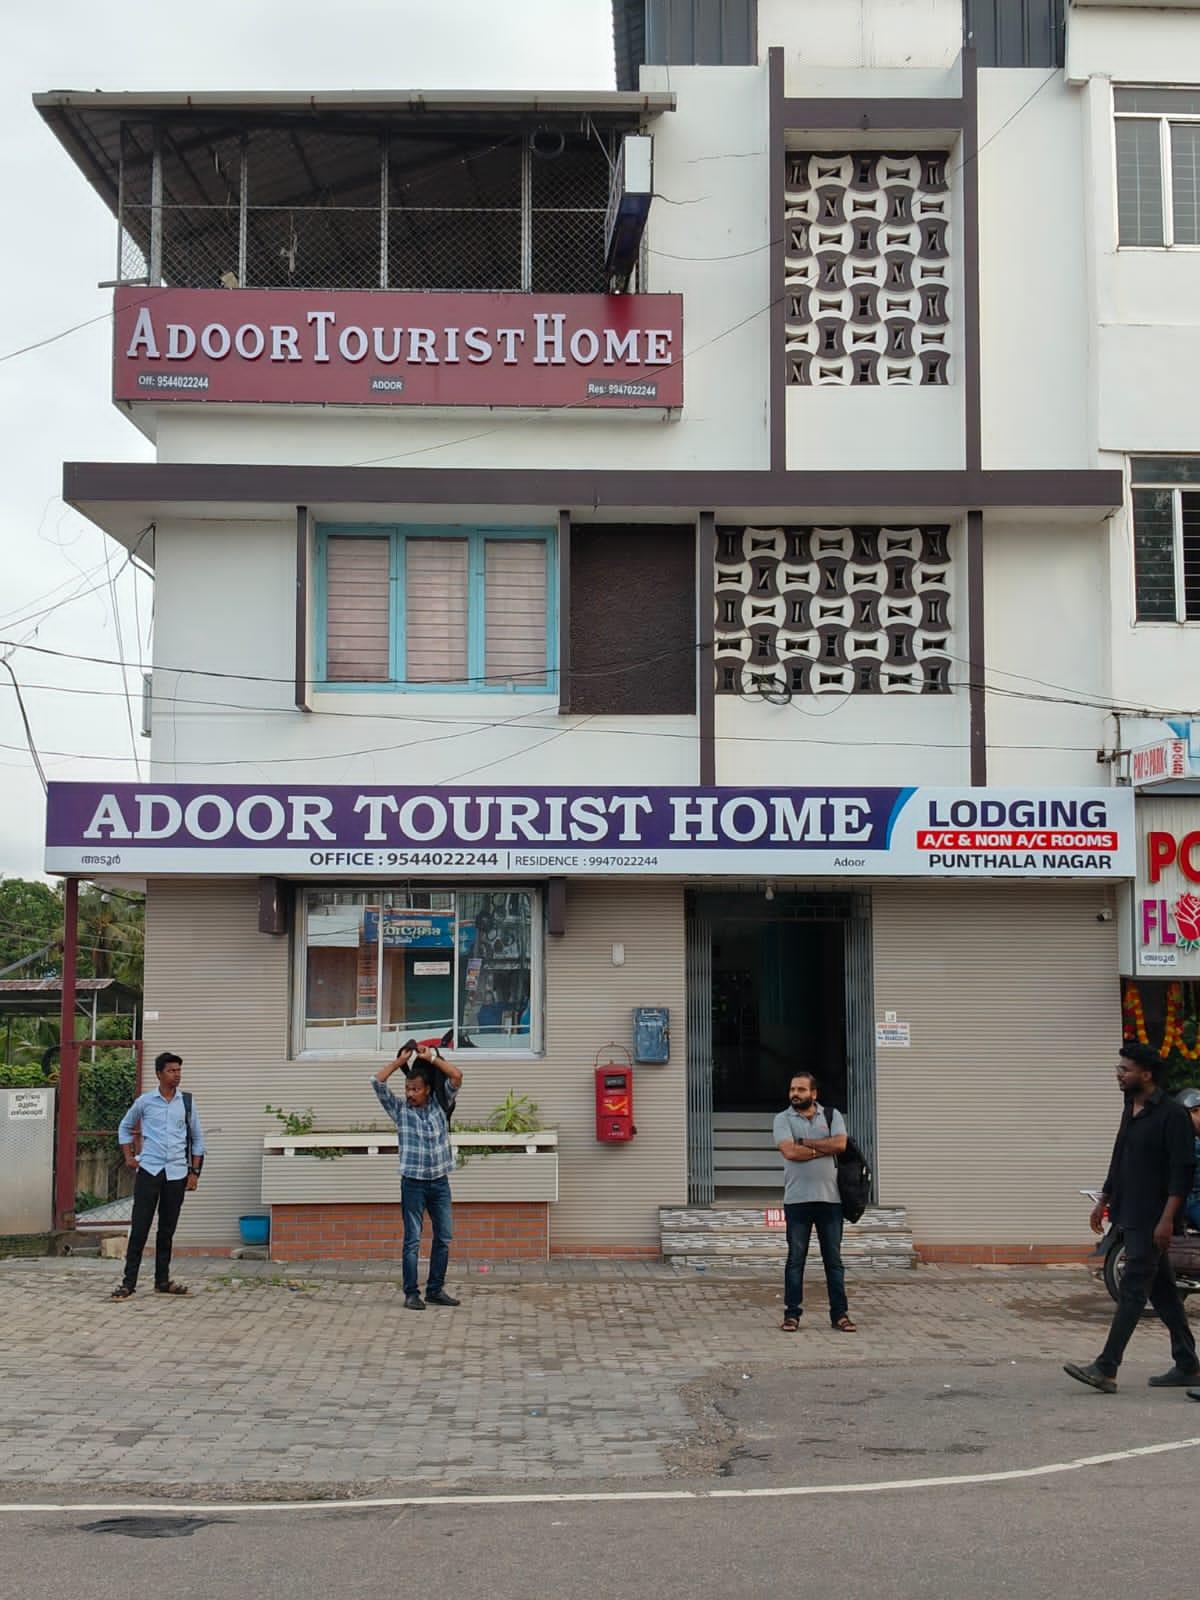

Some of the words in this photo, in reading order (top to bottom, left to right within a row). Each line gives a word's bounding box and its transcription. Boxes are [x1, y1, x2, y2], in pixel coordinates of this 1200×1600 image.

[532, 313, 672, 364] HOME
[157, 375, 209, 389] 9544022244
[372, 380, 402, 390] ADOOR
[83, 794, 337, 841] ADOOR
[353, 795, 653, 841] TOURIST
[669, 796, 873, 842] HOME
[928, 800, 1107, 828] LODGING
[923, 834, 954, 848] A/C
[957, 834, 971, 847] &
[975, 834, 1012, 847] NON
[1016, 834, 1047, 848] A/C
[1051, 835, 1113, 847] ROOMS
[310, 852, 373, 866] OFFICE
[387, 853, 498, 866] 9544022244
[515, 855, 578, 866] RESIDENCE
[589, 856, 658, 867] 9947022244
[833, 857, 866, 867] Adoor
[929, 854, 1036, 869] PUNTHALA
[1042, 855, 1112, 869] NAGAR
